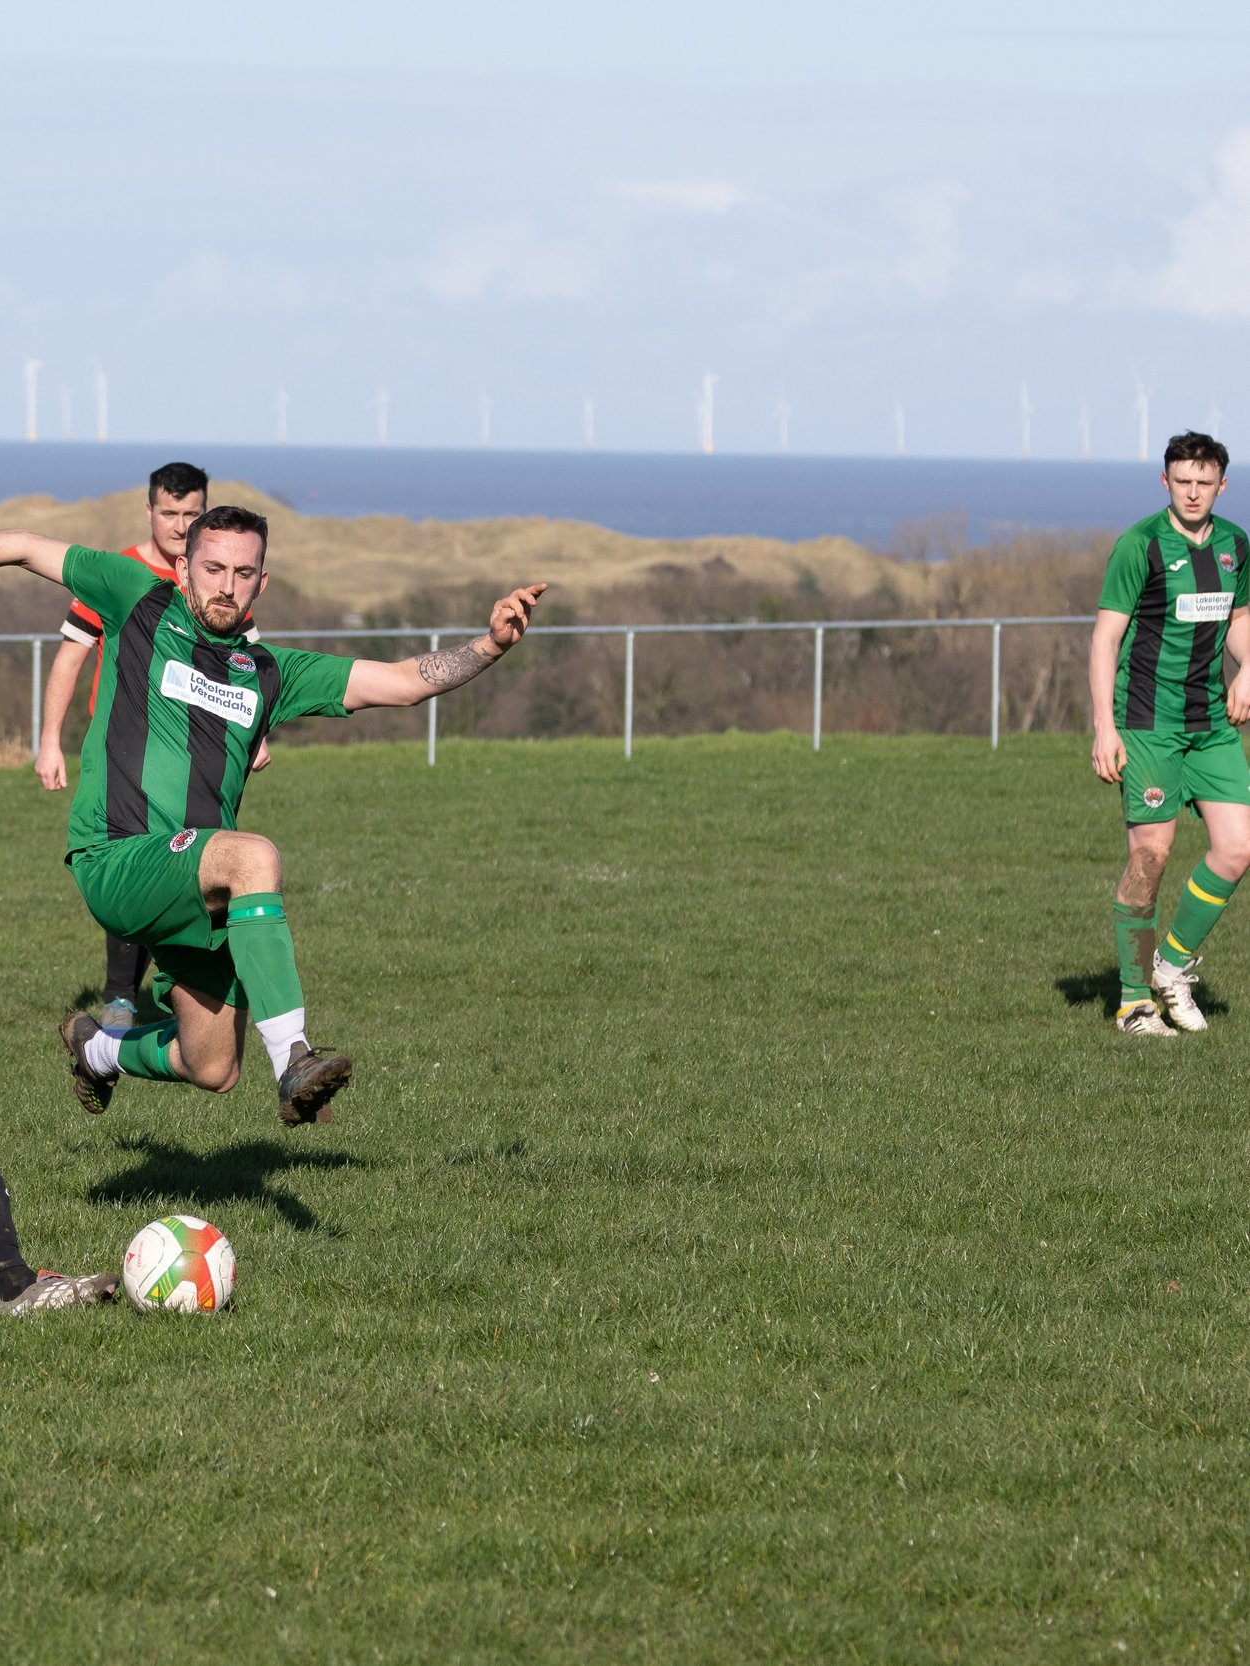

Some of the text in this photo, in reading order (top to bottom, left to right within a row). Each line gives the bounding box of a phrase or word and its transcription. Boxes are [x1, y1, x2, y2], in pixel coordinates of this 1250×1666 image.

[1196, 596, 1228, 604] Lakeland
[190, 672, 244, 700] Lakeland
[190, 682, 253, 716] Verandahs
